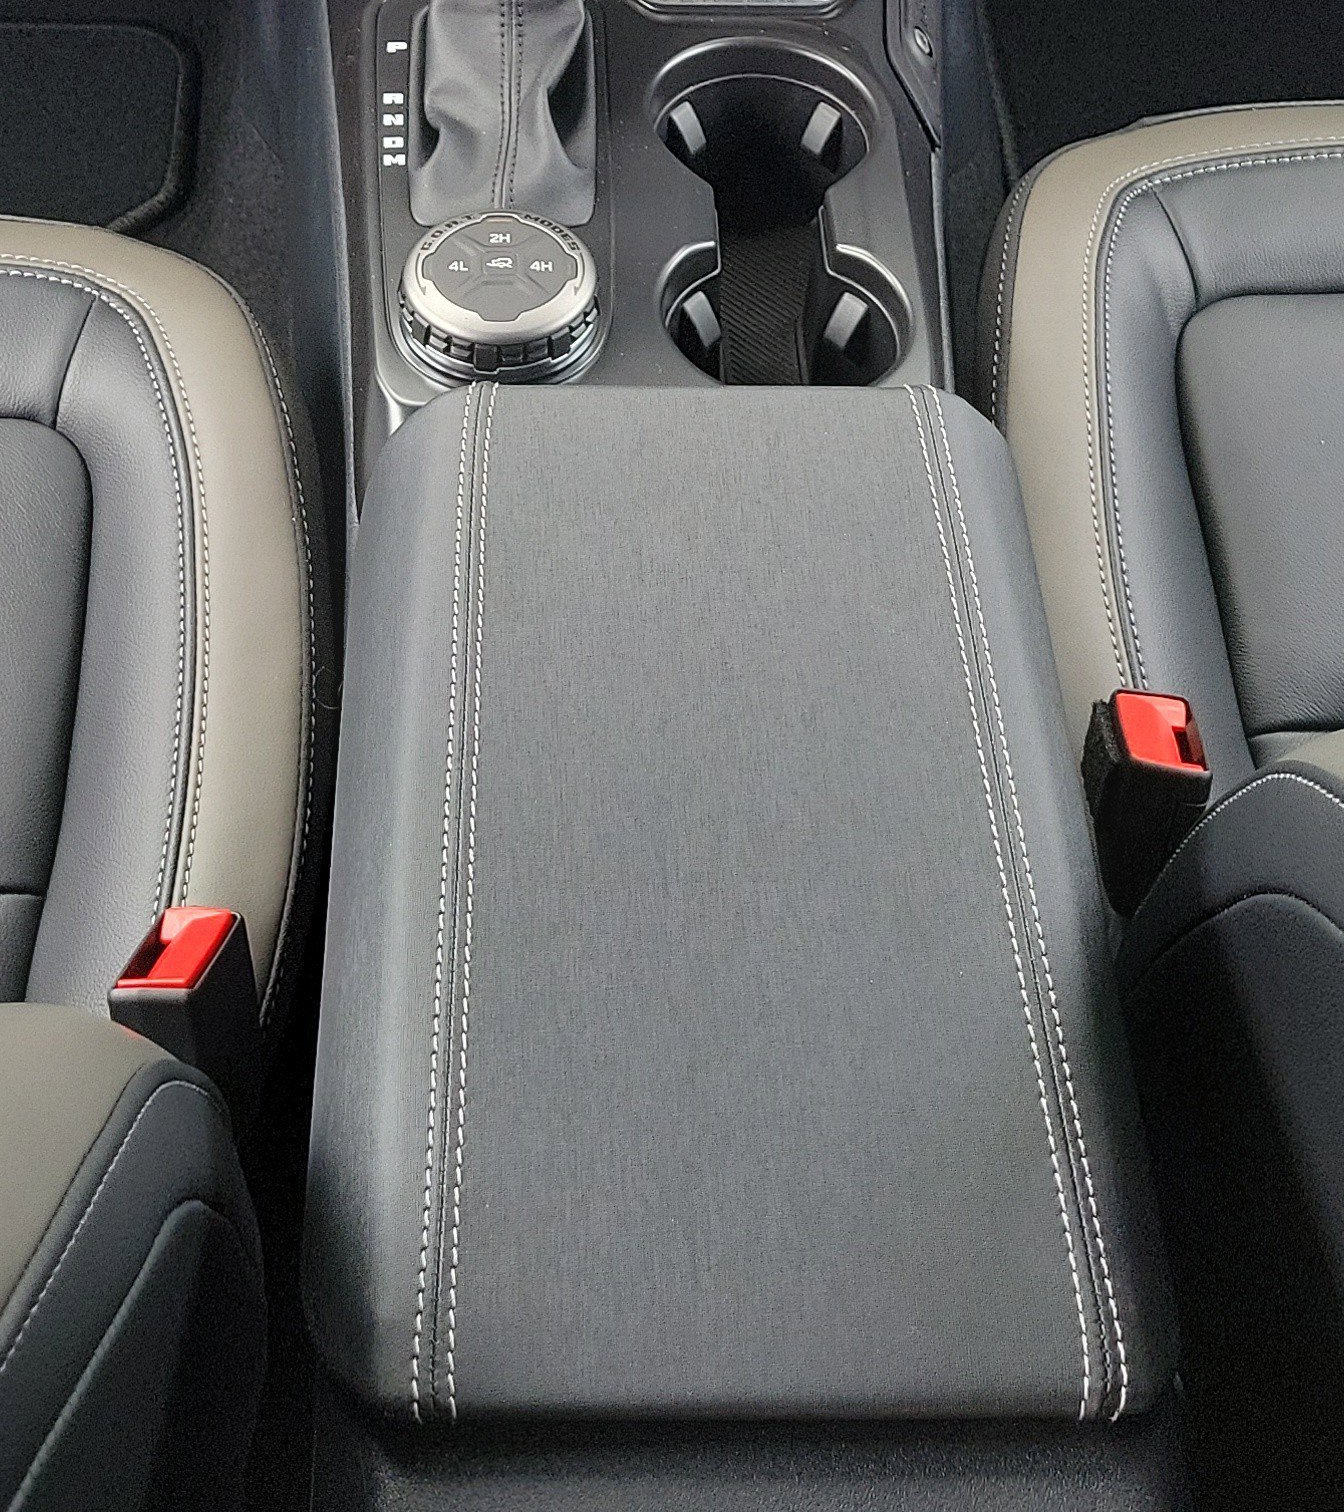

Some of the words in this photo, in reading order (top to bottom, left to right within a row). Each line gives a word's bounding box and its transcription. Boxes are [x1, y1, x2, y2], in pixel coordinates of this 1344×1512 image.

[386, 41, 408, 53] P
[383, 92, 404, 104] R
[383, 113, 404, 126] N
[383, 136, 404, 149] D
[383, 154, 406, 166] M
[489, 232, 511, 244] 2H
[523, 213, 582, 252] MODES
[448, 260, 469, 272] 4L
[530, 261, 554, 273] 4H
